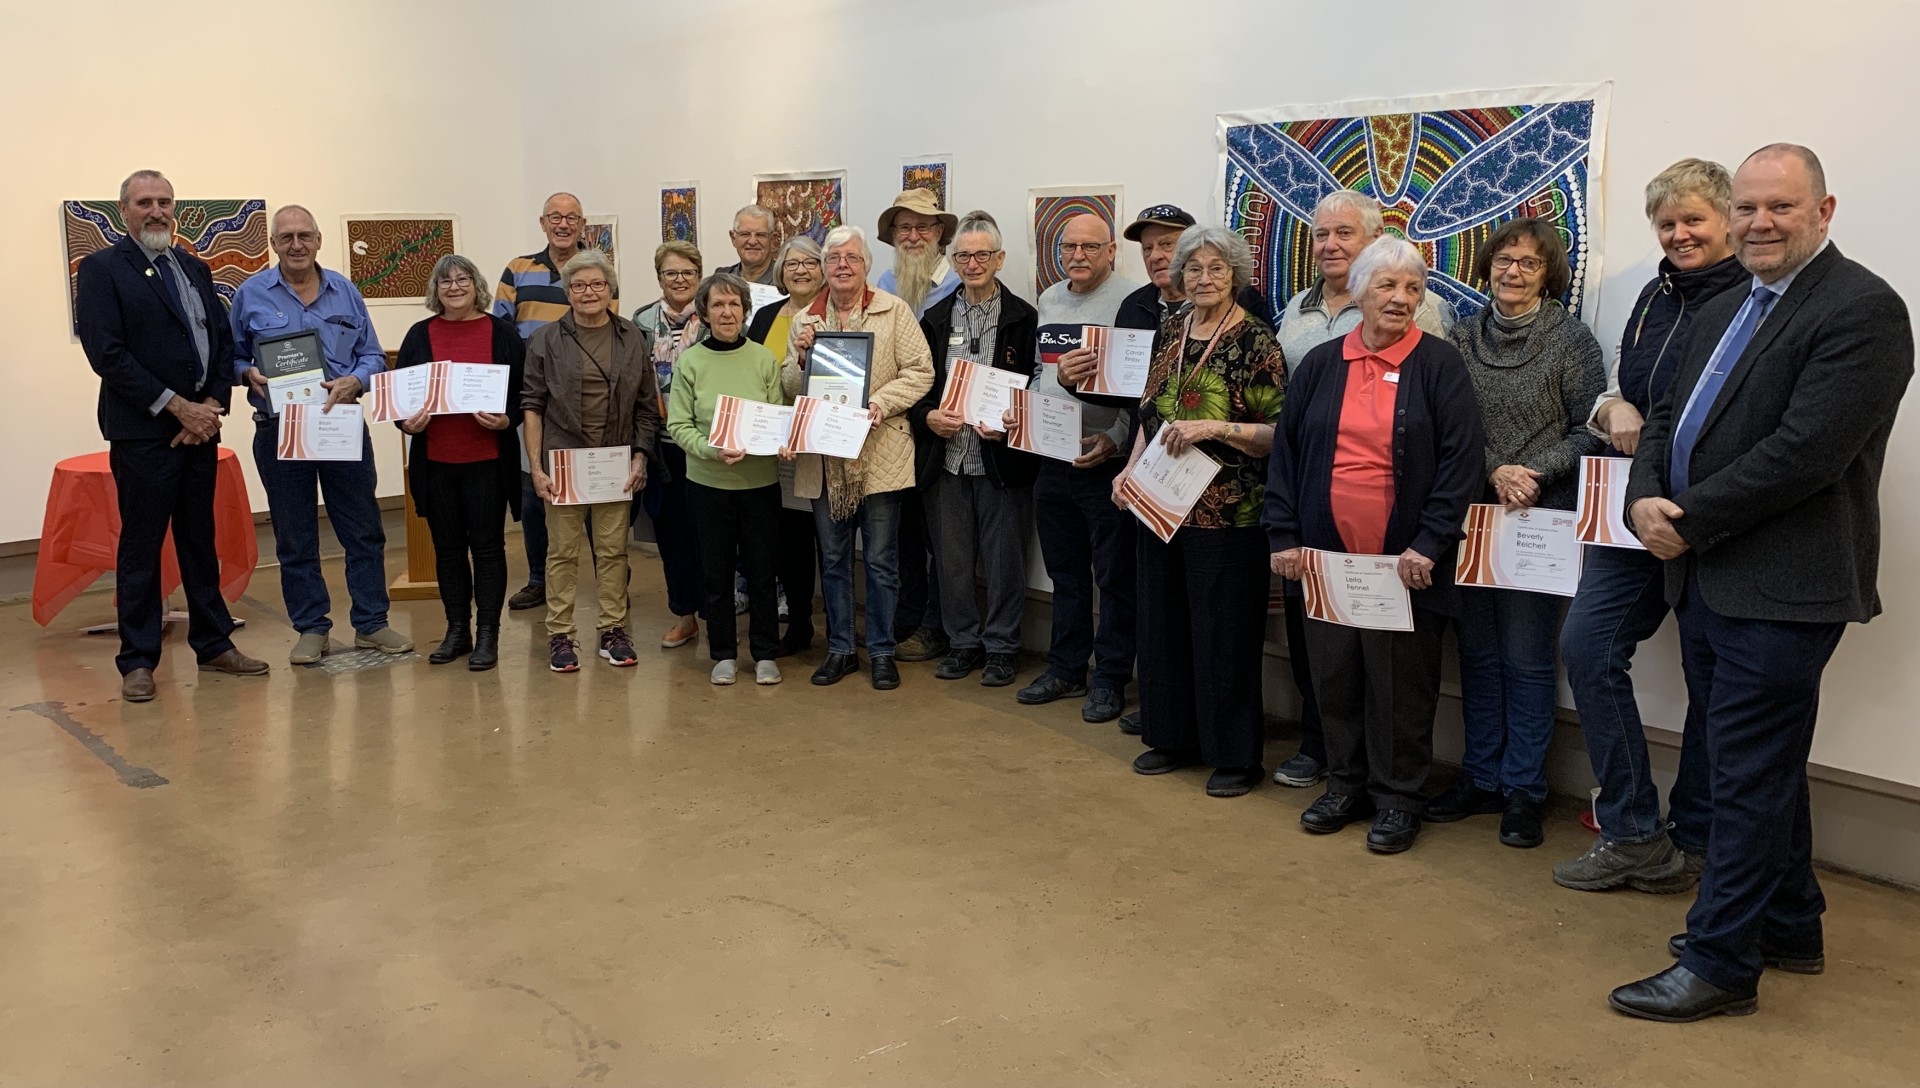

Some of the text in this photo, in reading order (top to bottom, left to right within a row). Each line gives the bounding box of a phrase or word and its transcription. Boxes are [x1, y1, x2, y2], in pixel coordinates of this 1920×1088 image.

[1040, 332, 1056, 344] Ben
[278, 352, 303, 360] Premier's
[275, 357, 308, 367] Certificate
[1517, 532, 1544, 541] Beverly
